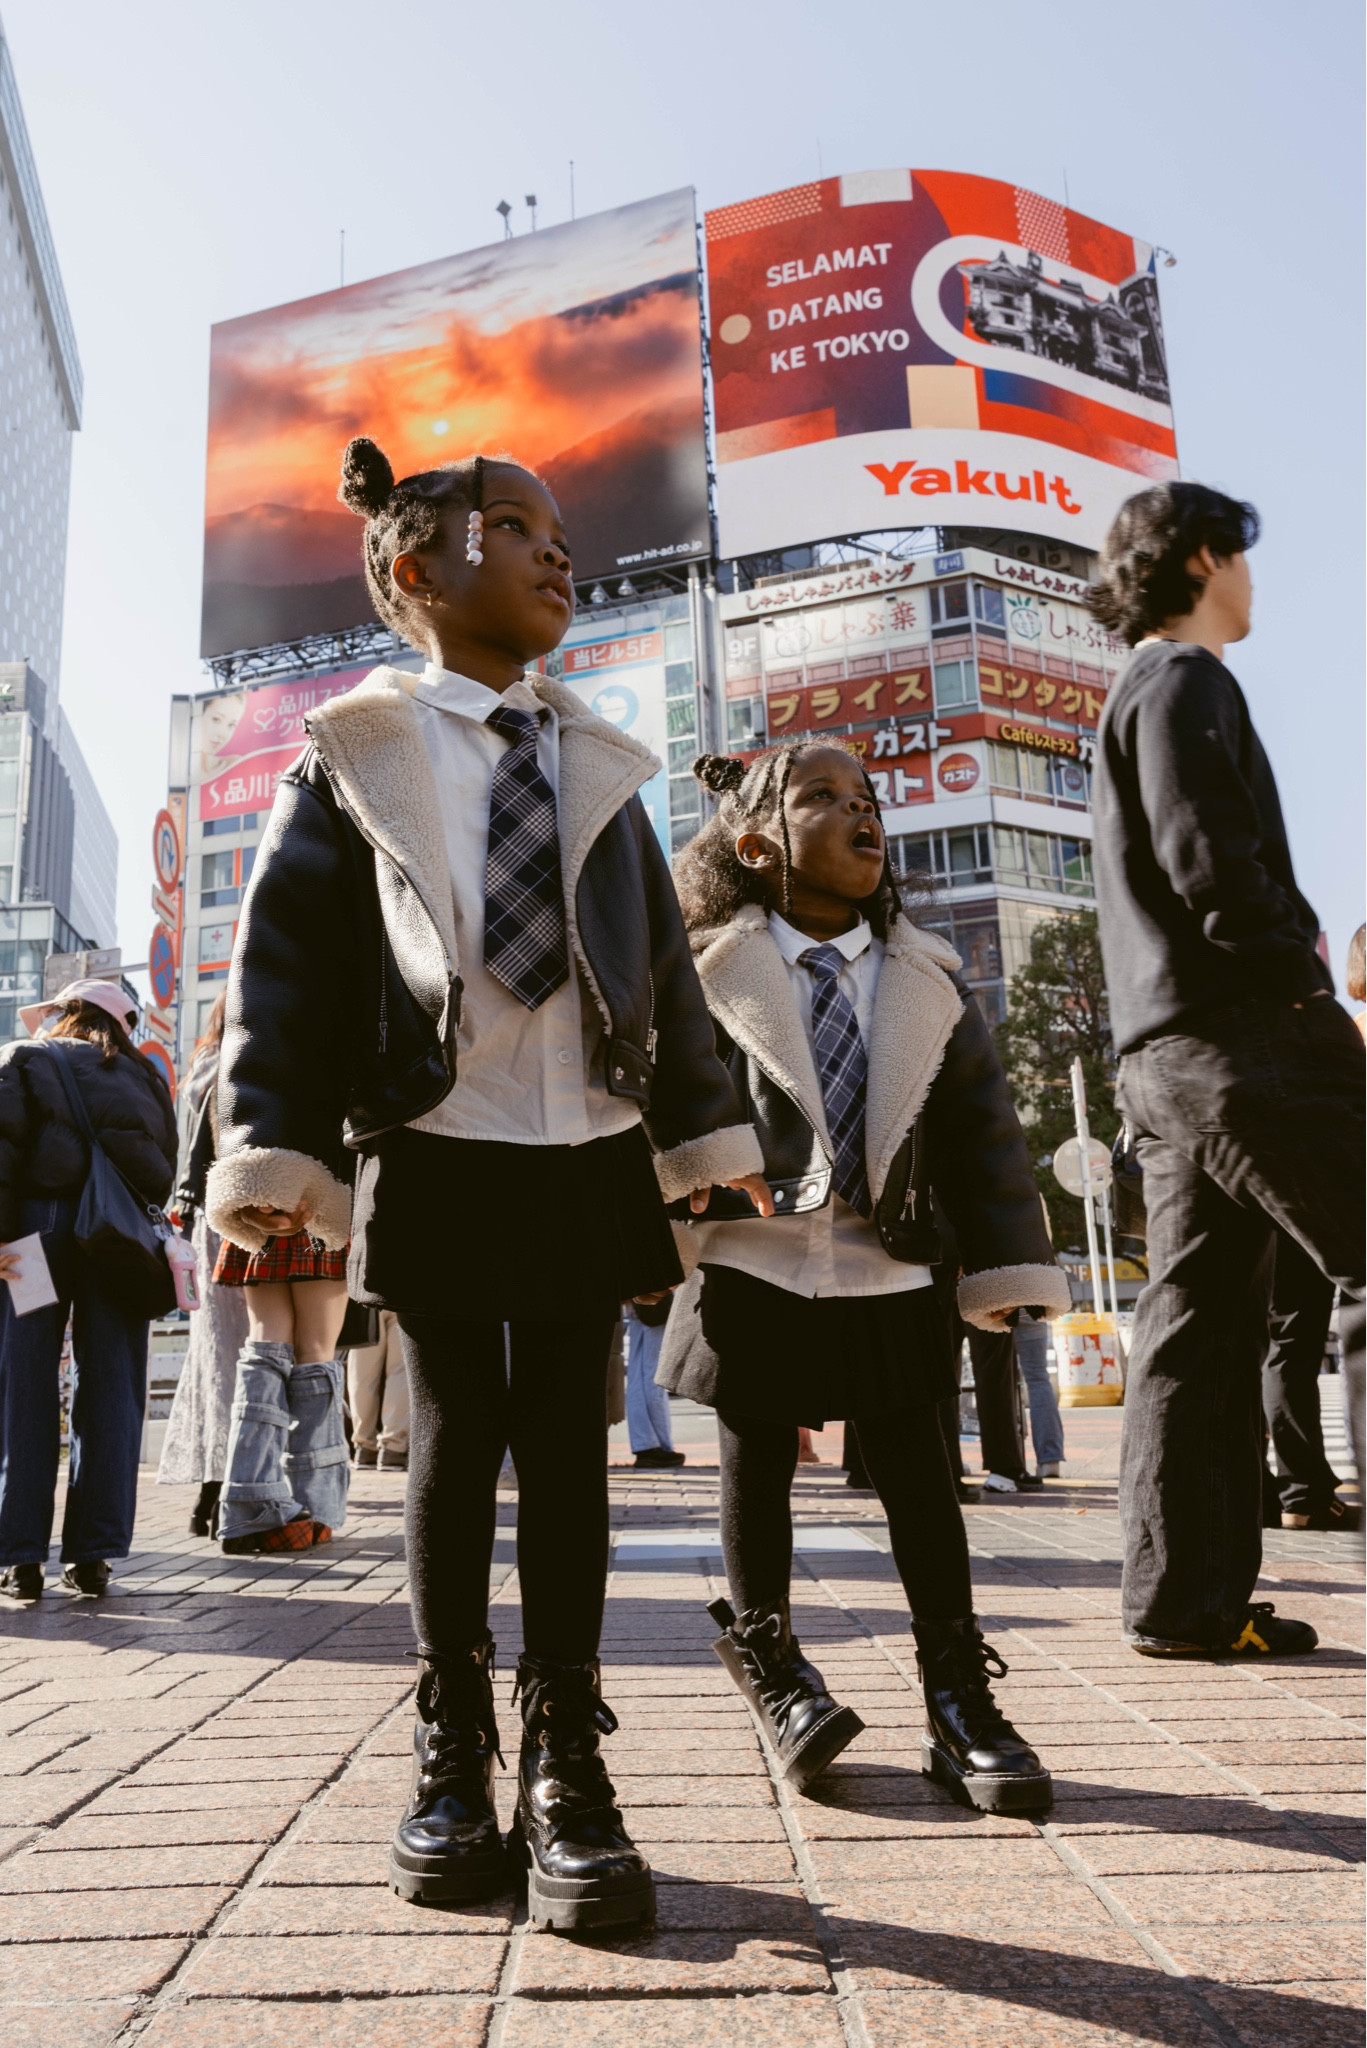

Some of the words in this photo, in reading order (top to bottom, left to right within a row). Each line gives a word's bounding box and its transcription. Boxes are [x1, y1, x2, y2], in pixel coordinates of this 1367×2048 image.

[766, 243, 893, 287] SELAMAT
[767, 287, 883, 331] DATANG
[770, 345, 807, 374] KE
[812, 328, 910, 363] TOKYO
[863, 460, 1083, 515] Yakult
[616, 540, 703, 566] www.hit-ad.co.jp
[745, 562, 916, 611] しゃぶしゃぶバイキング
[819, 601, 917, 644] しゃぶ葉
[573, 637, 653, 669] 当ビル5F
[727, 636, 758, 659] 9F
[769, 674, 928, 727] プライス
[979, 665, 1104, 719] コンタクト
[873, 721, 952, 758] ガスト
[943, 768, 977, 784] ガスト
